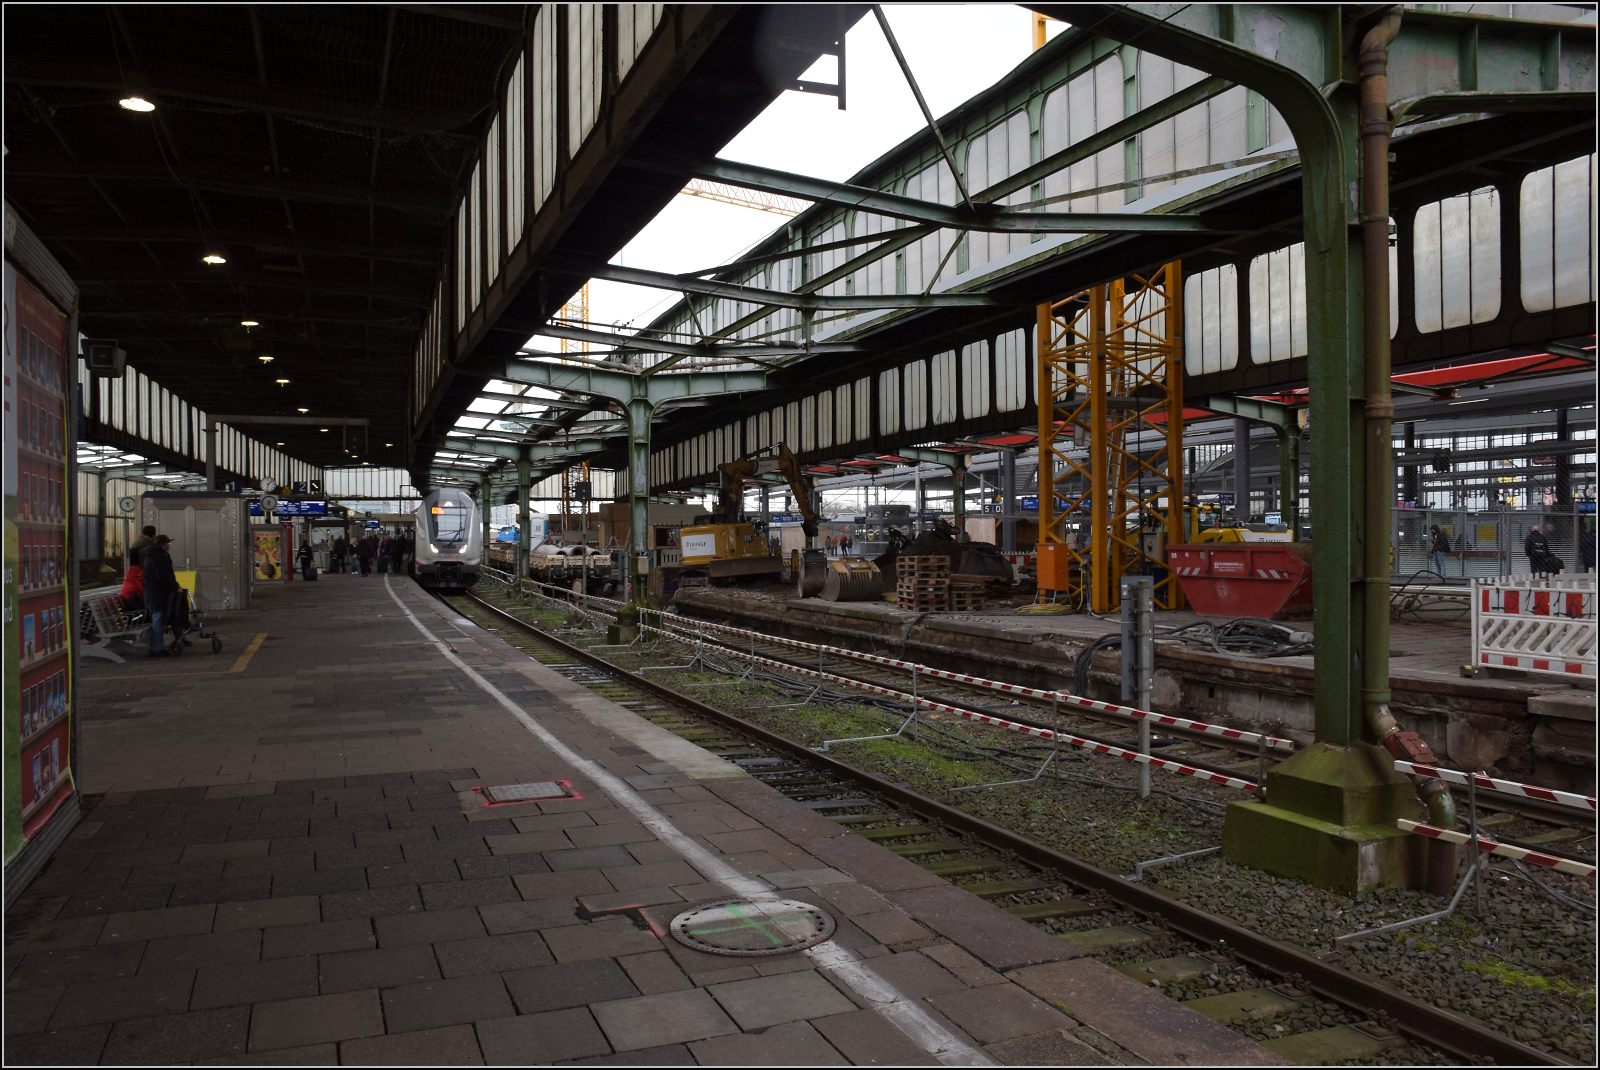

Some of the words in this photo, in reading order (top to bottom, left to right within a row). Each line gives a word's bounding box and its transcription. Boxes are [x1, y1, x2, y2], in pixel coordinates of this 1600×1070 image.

[299, 482, 307, 492] 2
[984, 505, 990, 513] 5
[995, 505, 1001, 513] D
